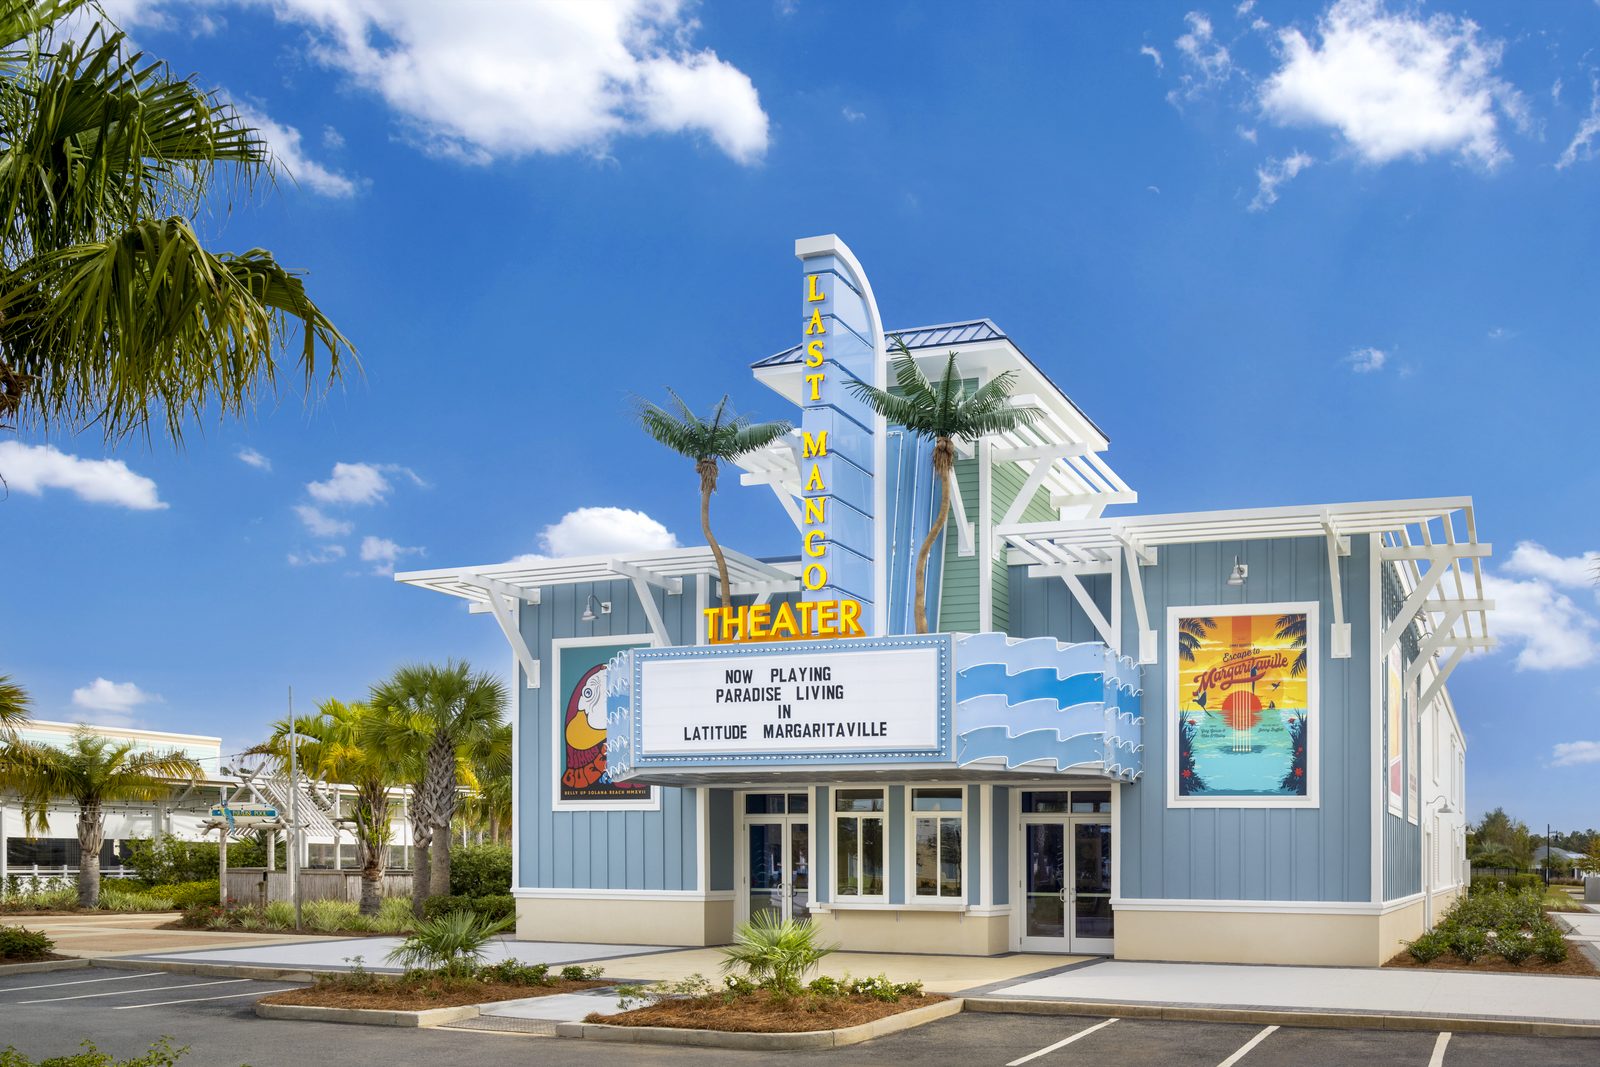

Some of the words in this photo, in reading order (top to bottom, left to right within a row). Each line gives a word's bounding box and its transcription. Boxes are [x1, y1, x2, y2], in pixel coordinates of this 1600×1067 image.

[805, 275, 826, 401] LAST
[802, 430, 828, 591] MANGO
[703, 599, 866, 643] THEATER
[1223, 651, 1252, 662] Escape
[725, 669, 753, 684] NOW
[770, 666, 832, 683] PLAYING
[1192, 652, 1289, 696] Margaritaville
[716, 686, 782, 703] PARADISE
[796, 685, 844, 701] LIVING
[778, 704, 791, 719] IN
[684, 724, 747, 741] LATITUDE
[763, 721, 887, 739] MARGARITAVILLE
